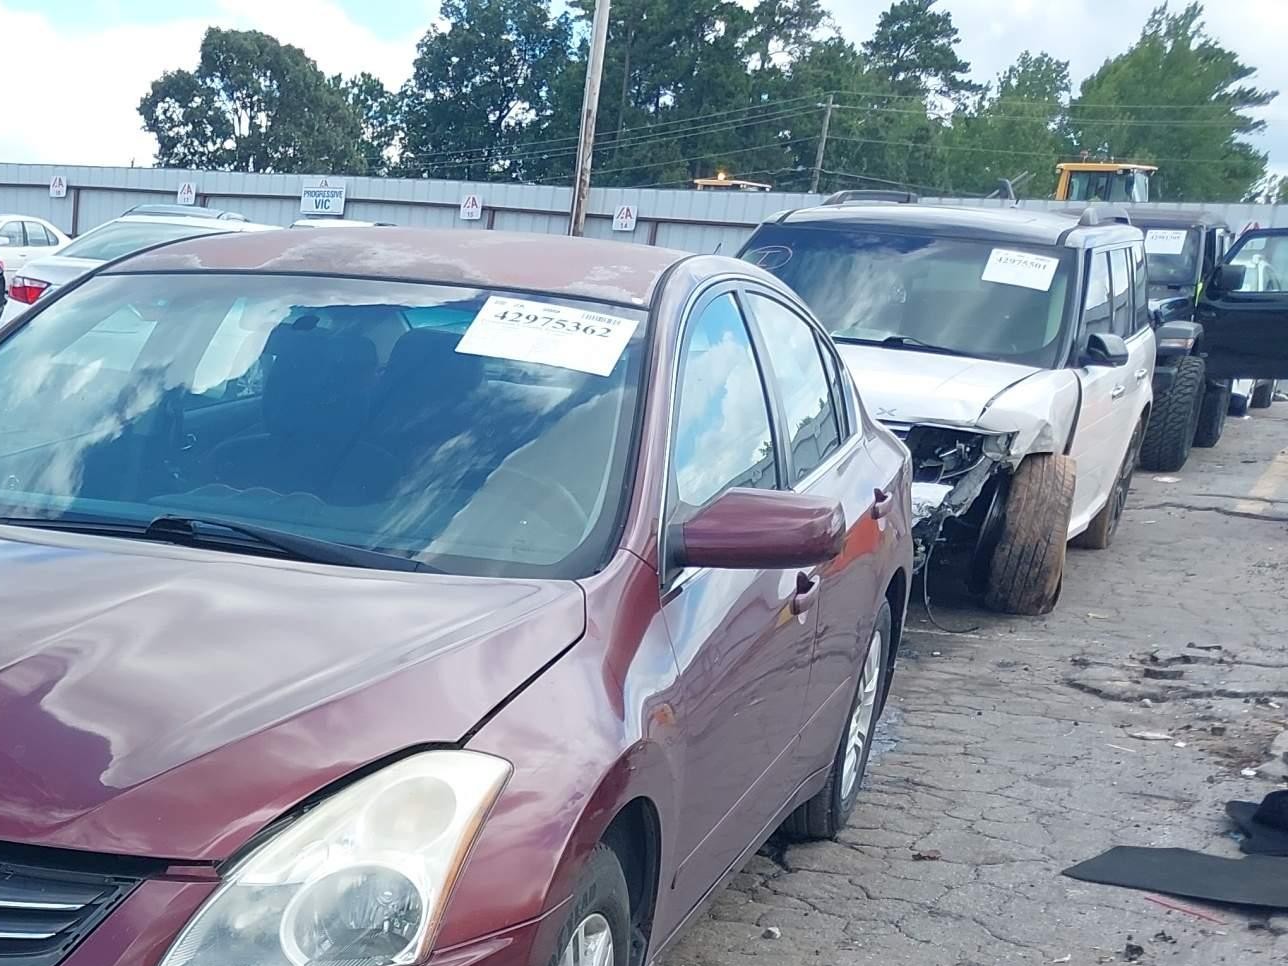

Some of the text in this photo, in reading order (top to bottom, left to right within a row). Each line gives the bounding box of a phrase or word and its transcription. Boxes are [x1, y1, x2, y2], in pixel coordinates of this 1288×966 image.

[303, 190, 343, 200] PROGRESSIVE
[314, 199, 331, 210] VIC
[493, 310, 613, 338] 42975362
